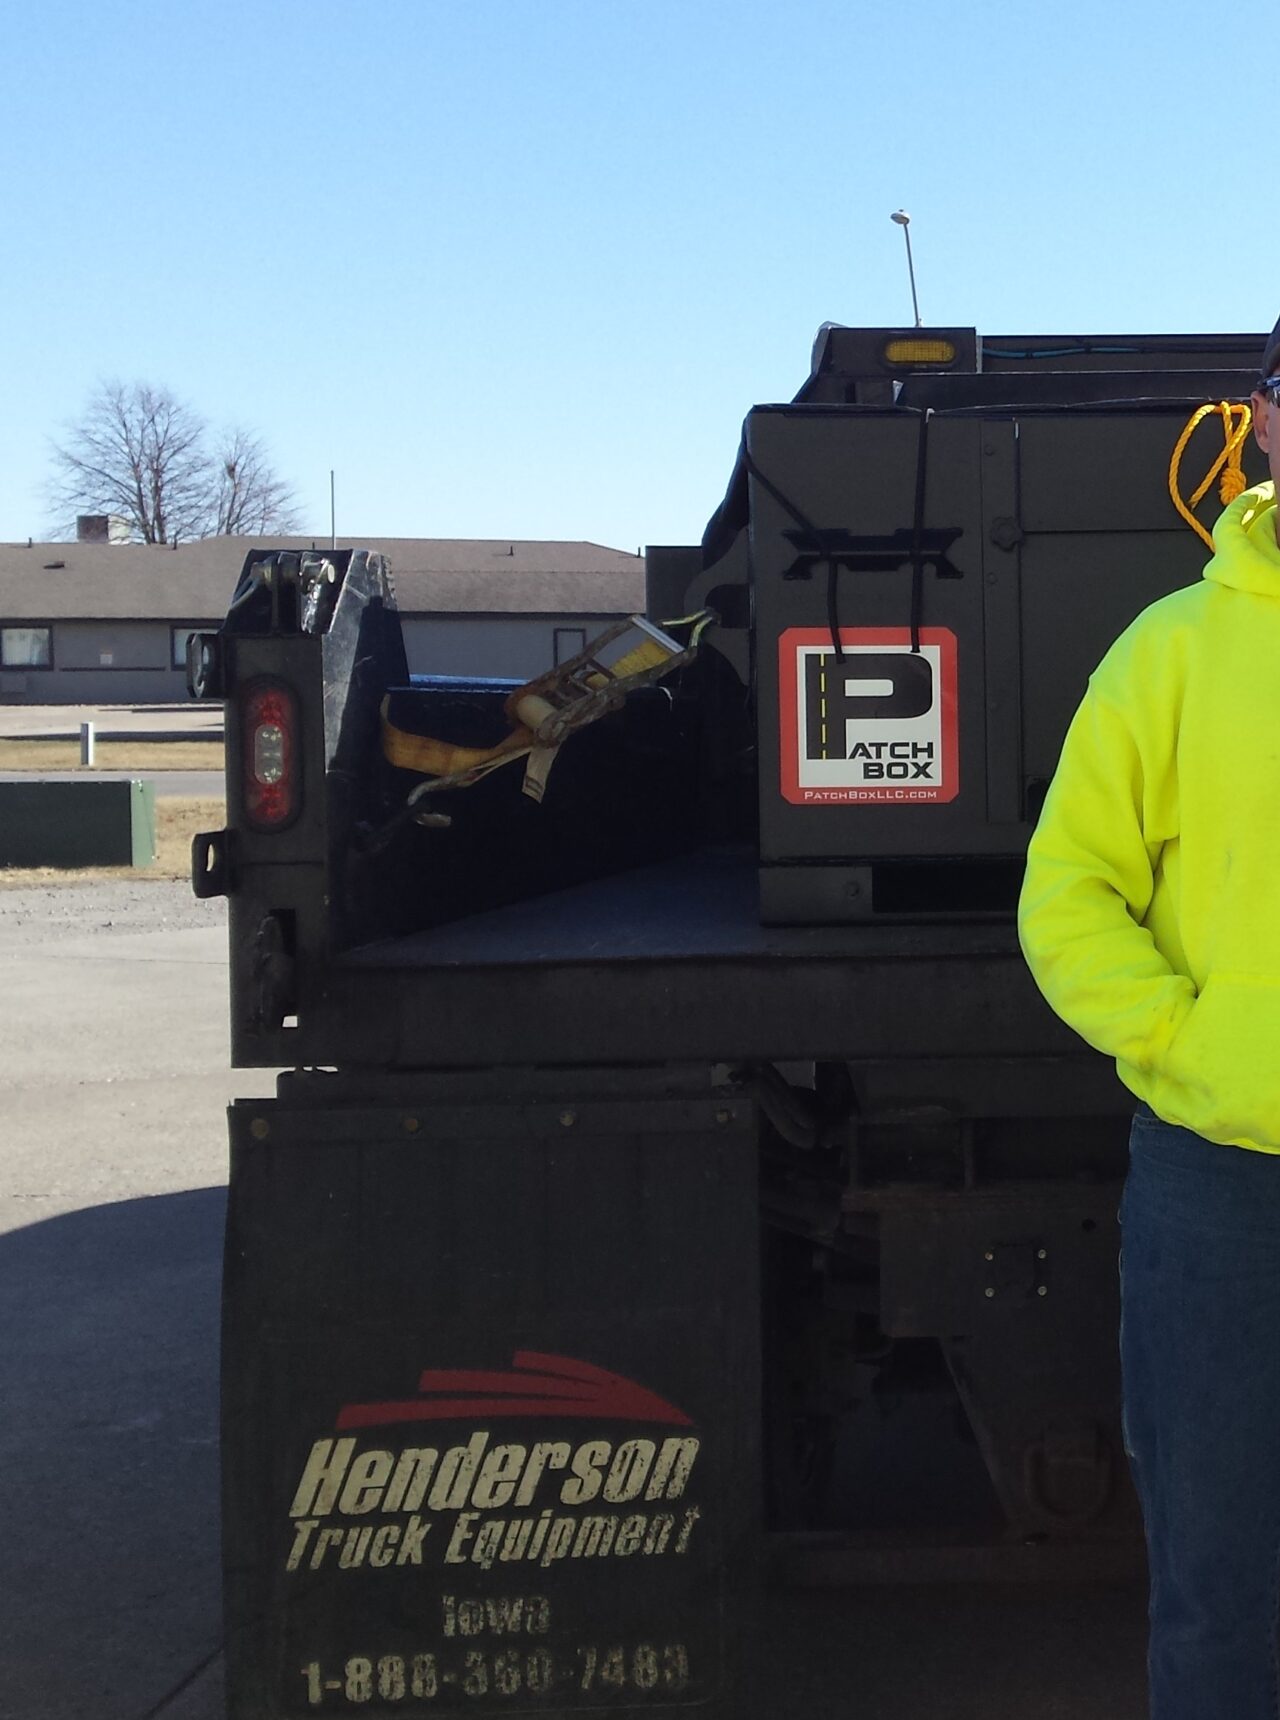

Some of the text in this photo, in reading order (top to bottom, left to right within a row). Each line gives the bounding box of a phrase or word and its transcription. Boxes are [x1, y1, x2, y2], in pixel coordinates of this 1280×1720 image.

[863, 762, 934, 779] BOX
[288, 1431, 700, 1518] Henderson
[286, 1505, 700, 1571] Truck Equipment
